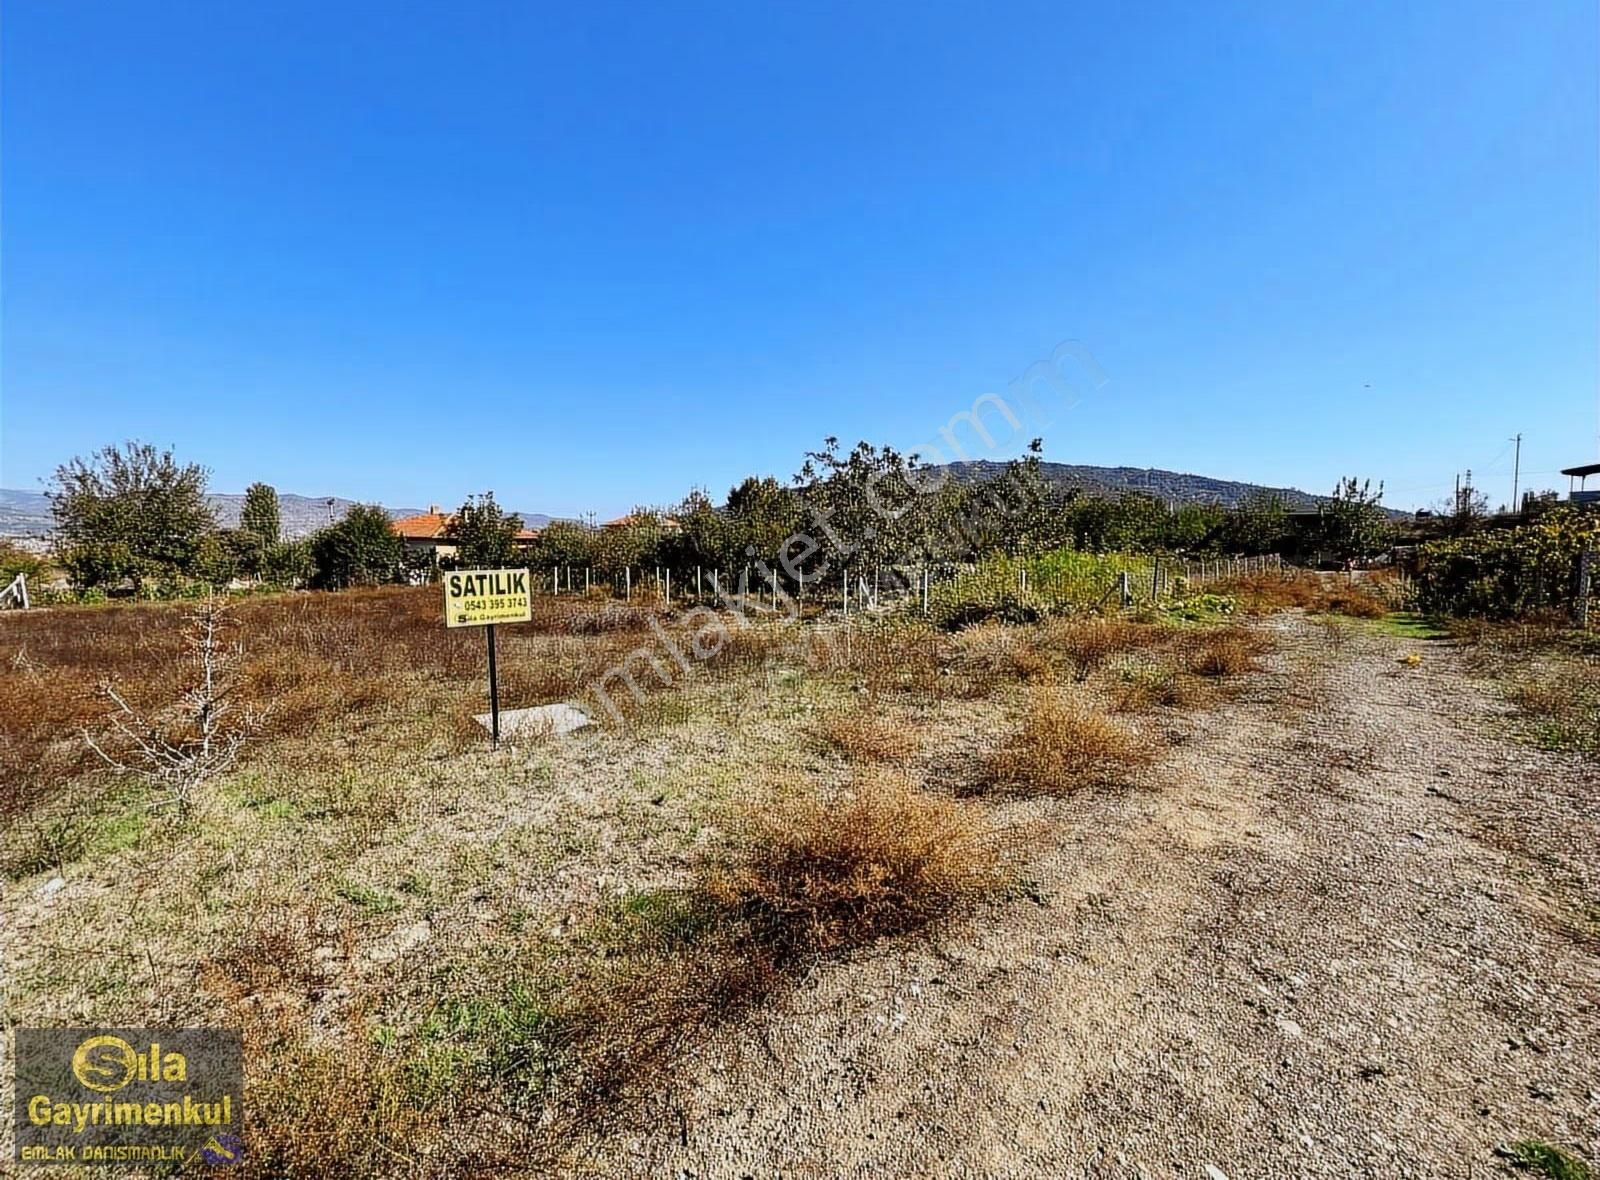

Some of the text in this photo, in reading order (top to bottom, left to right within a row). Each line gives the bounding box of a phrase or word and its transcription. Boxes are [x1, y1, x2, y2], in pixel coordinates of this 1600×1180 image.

[450, 573, 526, 597] SATILIK
[464, 600, 487, 611] 0543
[507, 598, 528, 608] 3743
